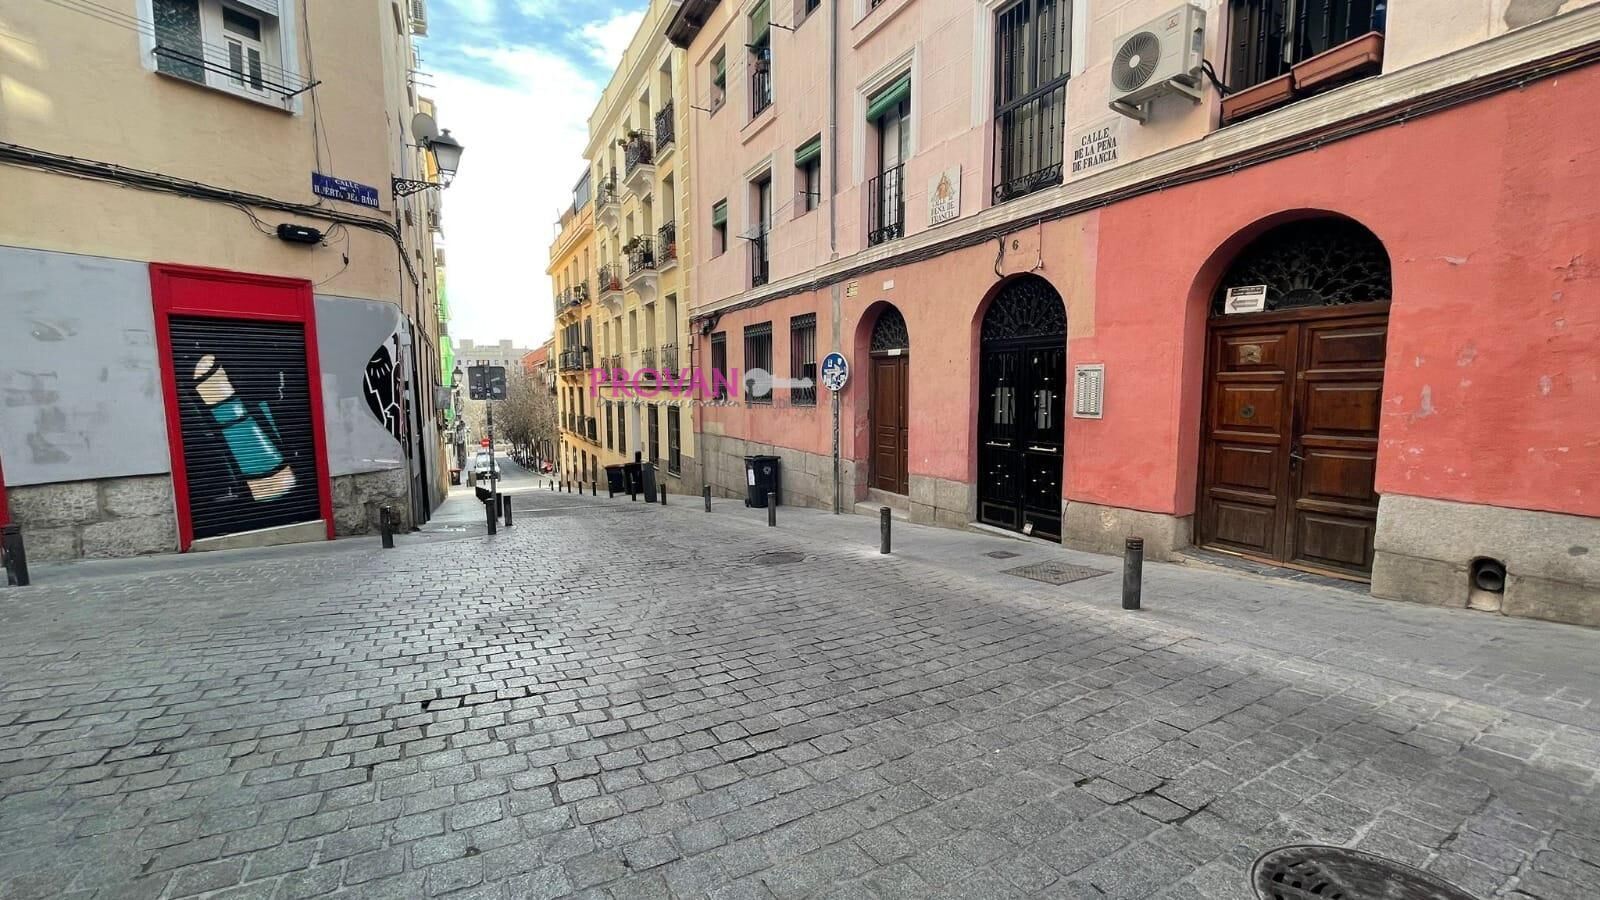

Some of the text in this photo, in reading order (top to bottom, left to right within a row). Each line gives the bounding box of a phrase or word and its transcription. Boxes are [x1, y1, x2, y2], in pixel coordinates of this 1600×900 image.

[1081, 127, 1110, 146] CALLE
[1074, 136, 1117, 160] DE LA PEÑA
[1072, 149, 1117, 172] DE FRANCIA
[334, 179, 360, 190] CALLE
[1012, 239, 1020, 251] 6
